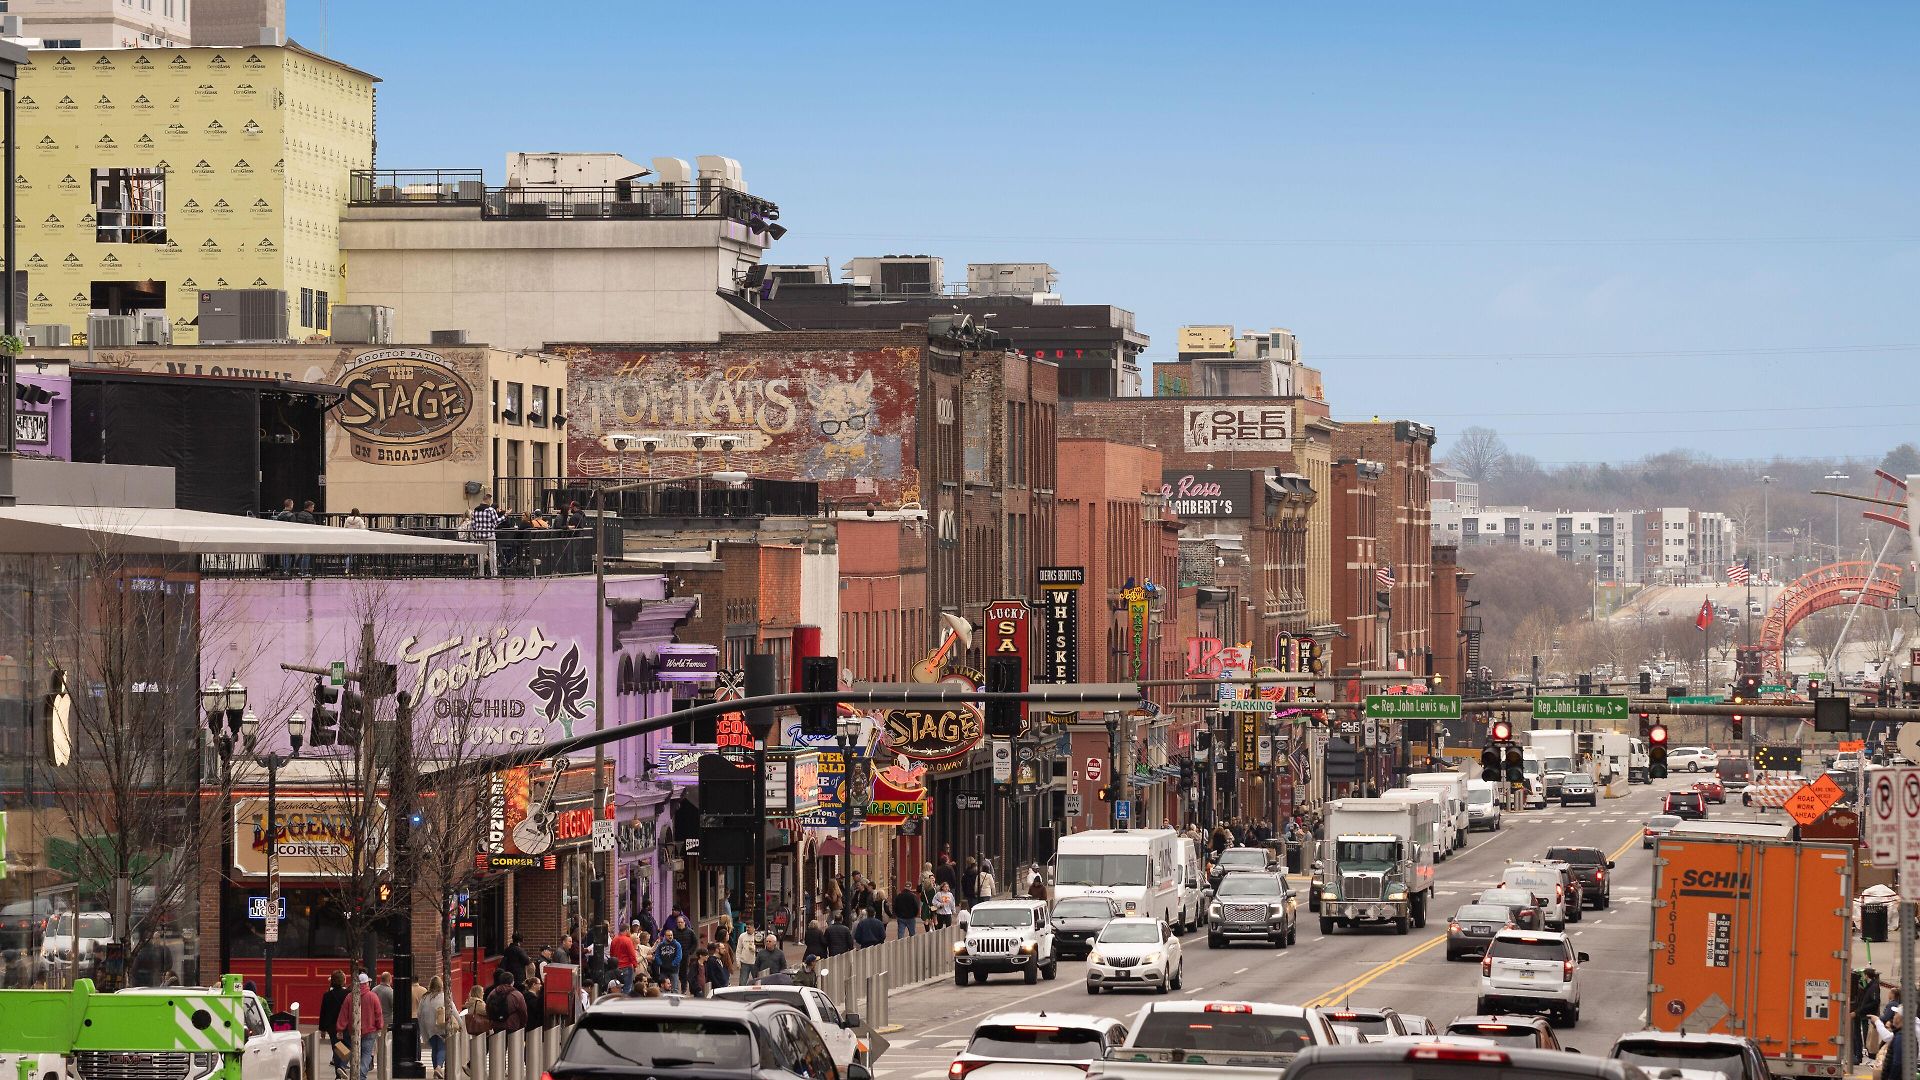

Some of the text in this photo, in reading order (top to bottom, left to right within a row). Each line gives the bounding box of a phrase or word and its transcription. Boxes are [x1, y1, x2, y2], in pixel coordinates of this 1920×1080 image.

[358, 351, 442, 364] ROOFTOP PATIO
[341, 372, 464, 425] STAGE
[1212, 411, 1286, 425] OLE
[1212, 426, 1286, 440] RED
[356, 443, 447, 461] ON BROADWAY
[1178, 475, 1222, 498] Rosa
[1040, 570, 1057, 581] DIERKS
[988, 608, 1026, 620] LUCKY
[1053, 591, 1069, 684] WHISKE
[398, 626, 558, 709] Tootsies
[666, 659, 706, 668] World Famous
[434, 698, 526, 719] ORCHID
[1231, 701, 1272, 711] PARKING
[1381, 700, 1396, 714] Rep.
[1397, 700, 1414, 712] John
[1416, 699, 1436, 712] Lewis
[1451, 700, 1456, 713] N
[1538, 700, 1552, 715] Rep.
[1553, 700, 1570, 713] John
[1572, 700, 1593, 713] Lewis
[1607, 702, 1612, 715] S
[722, 712, 741, 721] THE
[882, 708, 979, 746] STAGE
[432, 726, 545, 745] LOUNGE
[252, 813, 364, 850] LEGEND
[278, 845, 340, 855] CORNER
[1667, 878, 1678, 965] TA161035
[111, 1055, 150, 1064] GMC
